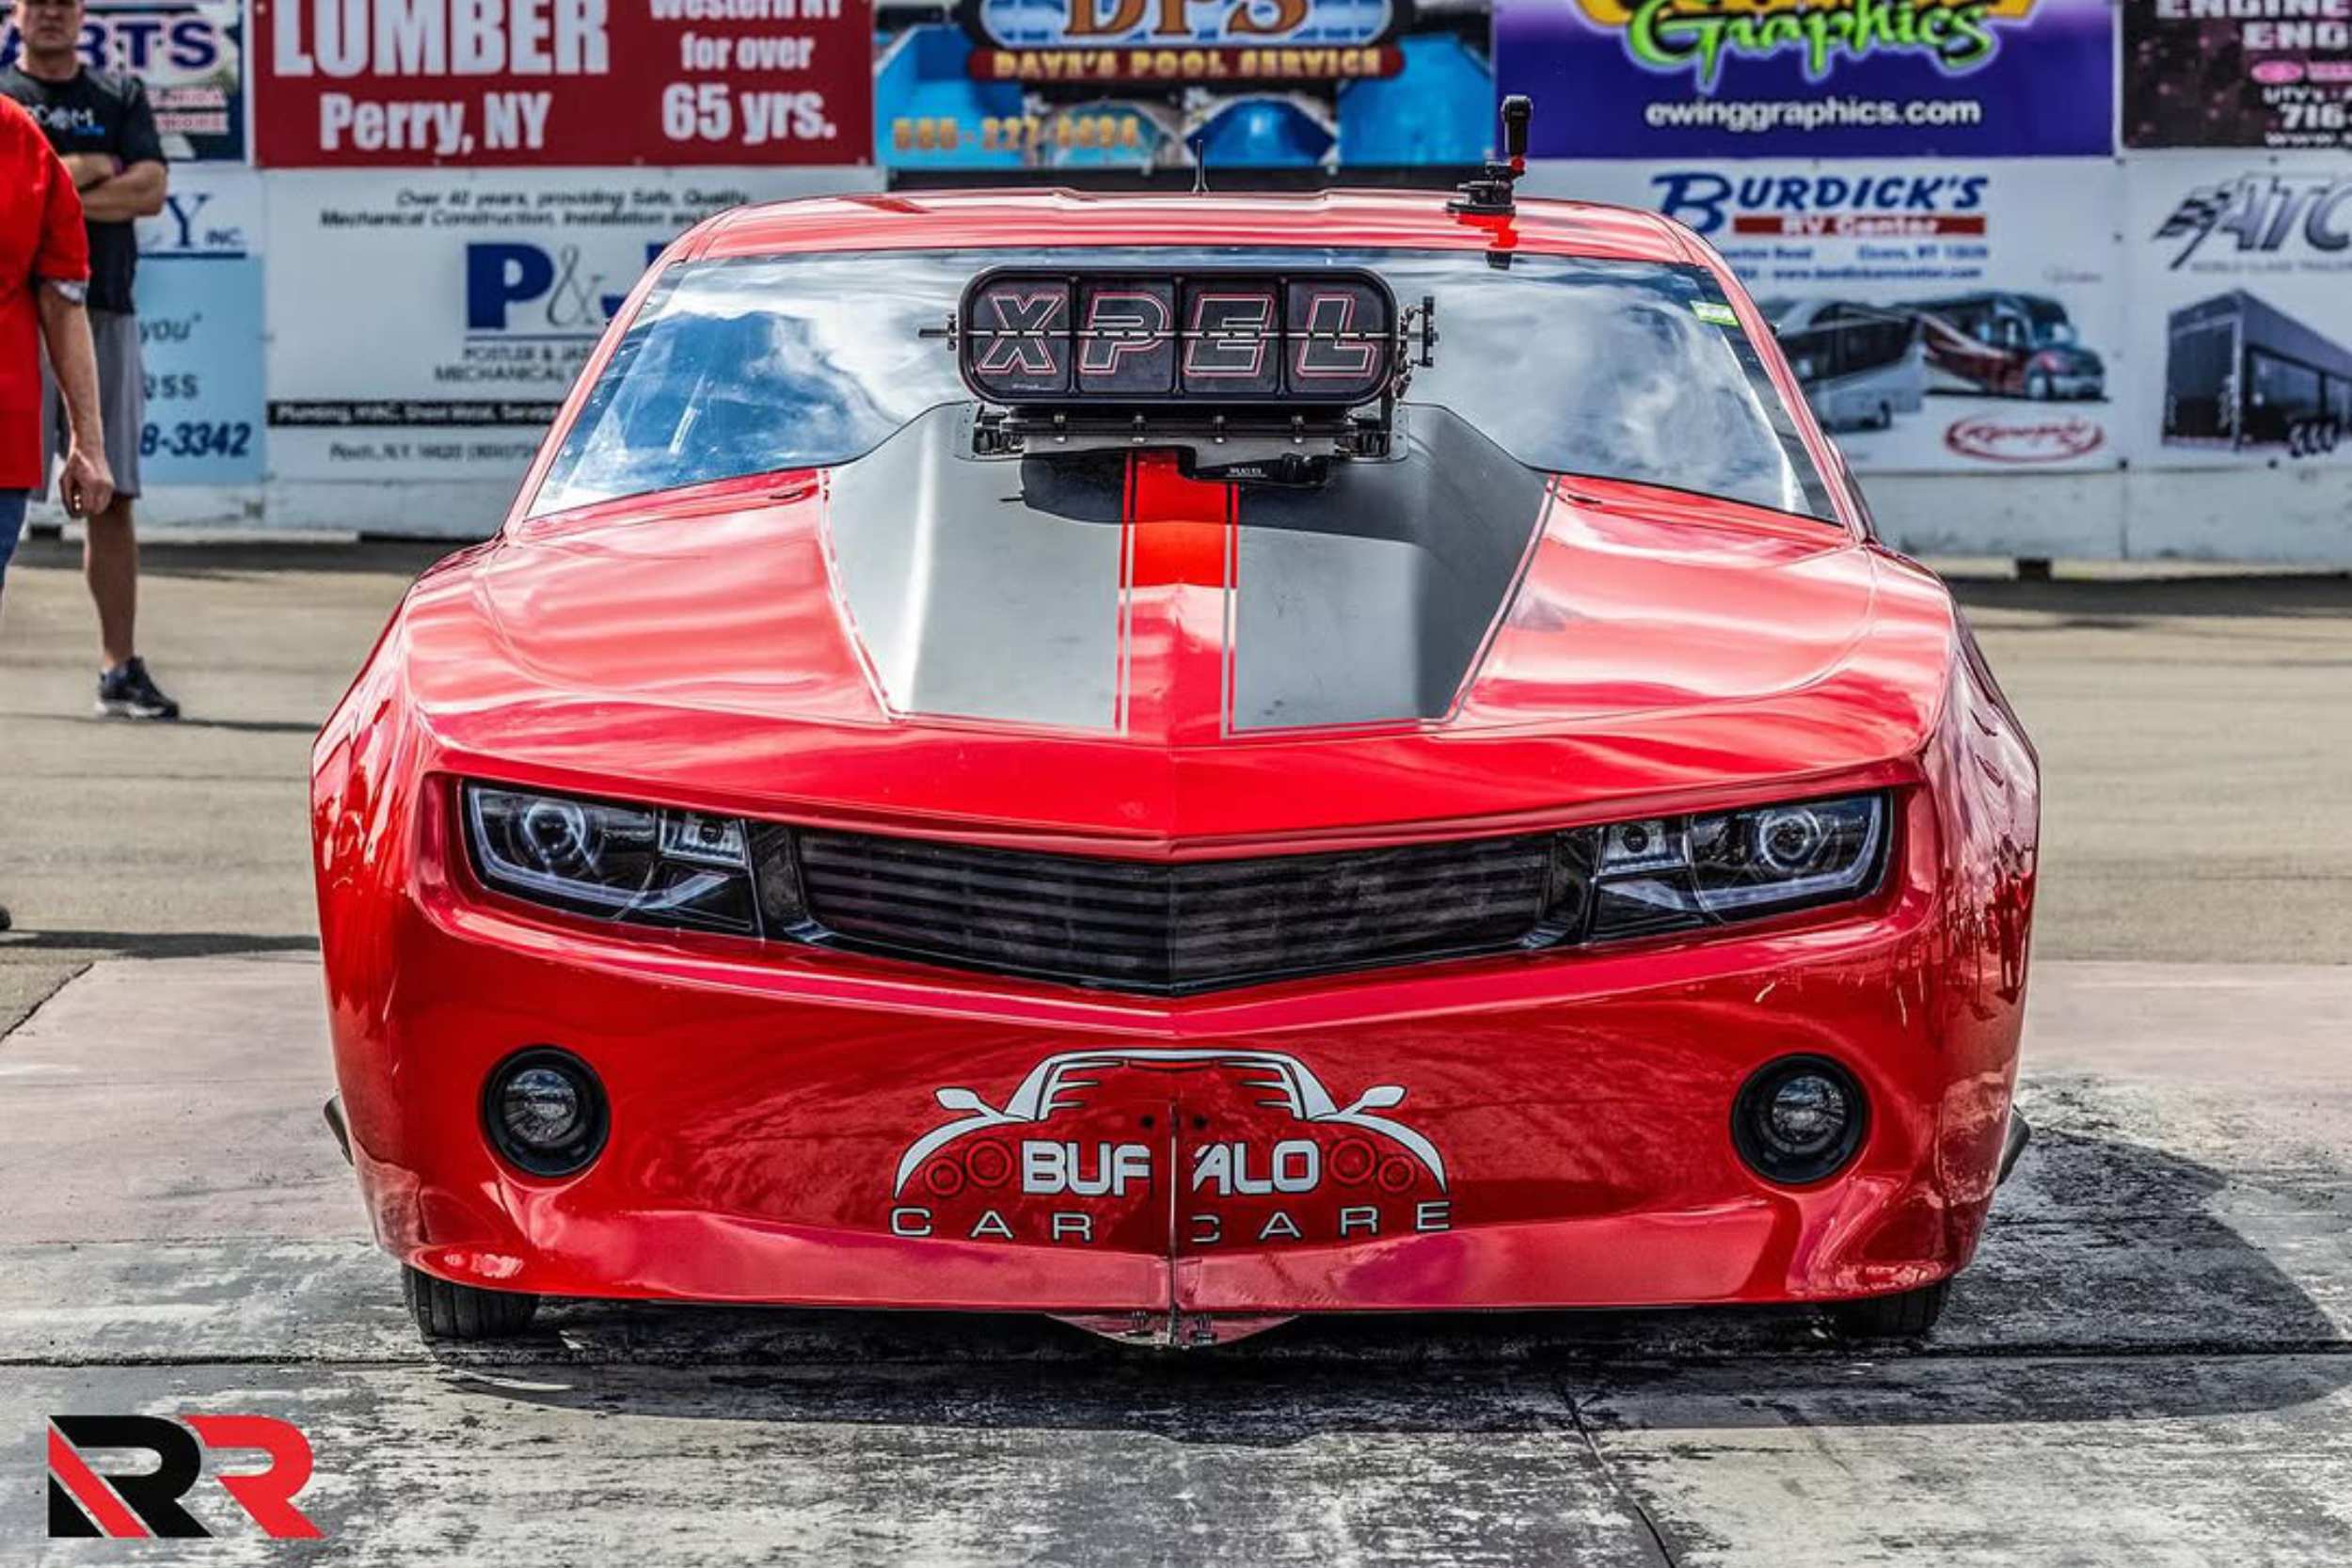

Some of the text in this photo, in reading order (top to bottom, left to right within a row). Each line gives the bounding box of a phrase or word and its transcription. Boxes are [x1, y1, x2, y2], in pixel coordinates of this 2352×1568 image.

[274, 0, 610, 76] LUMBER
[680, 31, 816, 71] for over
[993, 49, 1382, 78] DAVE'S POOL SERVICE
[1627, 0, 1996, 90] Graphics
[320, 91, 552, 156] Perry, NY
[662, 83, 837, 145] 65 yrs.
[1645, 96, 1979, 131] ewinggraphics.com
[319, 210, 423, 227] Mechanical
[564, 209, 663, 226] Installation
[396, 190, 440, 206] Over
[537, 191, 625, 214] providing
[1651, 171, 1989, 235] BURDICK'S
[972, 290, 1381, 377] XPEL
[890, 1206, 1093, 1243] CAR
